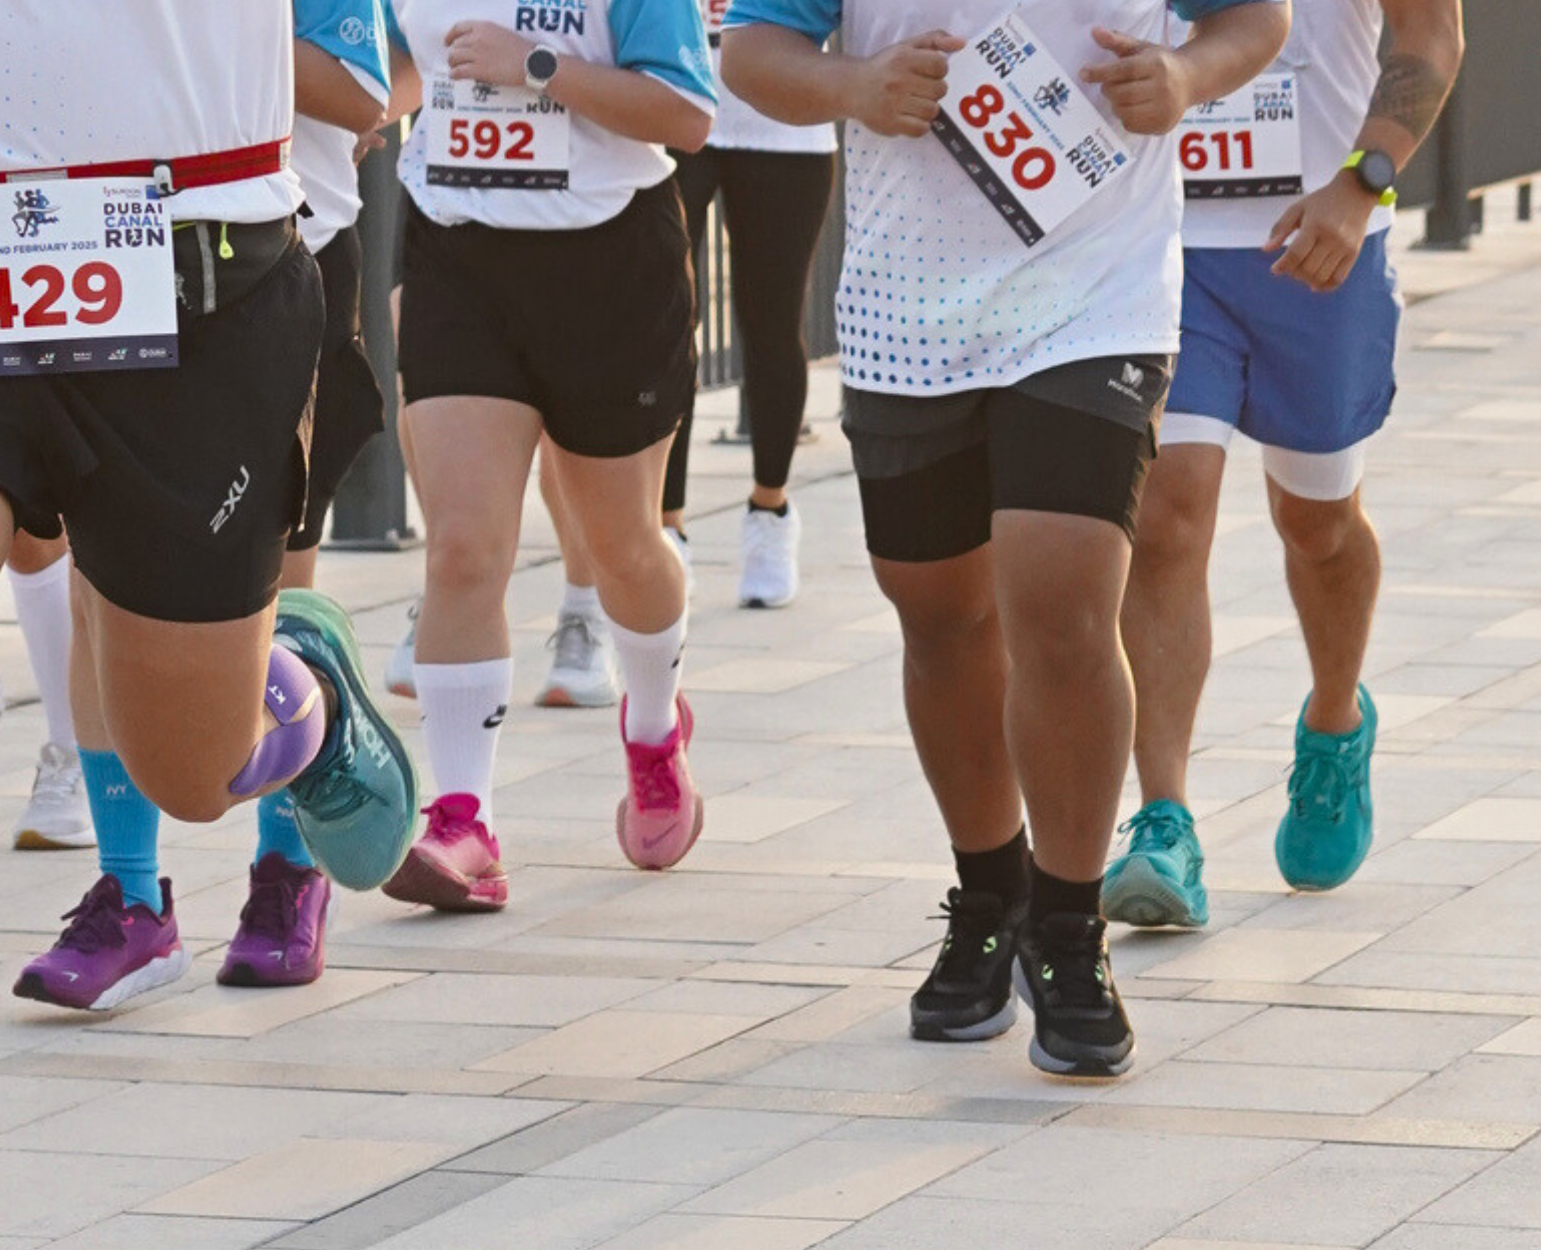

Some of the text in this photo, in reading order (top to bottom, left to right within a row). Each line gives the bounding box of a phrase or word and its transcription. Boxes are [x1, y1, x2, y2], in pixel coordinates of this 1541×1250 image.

[516, 6, 584, 35] RUN
[975, 40, 1012, 79] RUN
[1255, 107, 1293, 122] RUN
[449, 118, 534, 160] 592
[959, 84, 1056, 191] 830
[1179, 130, 1253, 171] 611
[1066, 148, 1102, 188] RUN
[103, 203, 163, 215] DUBAI
[105, 215, 163, 228] CANAL
[13, 243, 68, 254] FEBRUARY
[71, 241, 98, 250] 2025
[105, 228, 165, 248] RUN
[209, 465, 250, 534] 2XU
